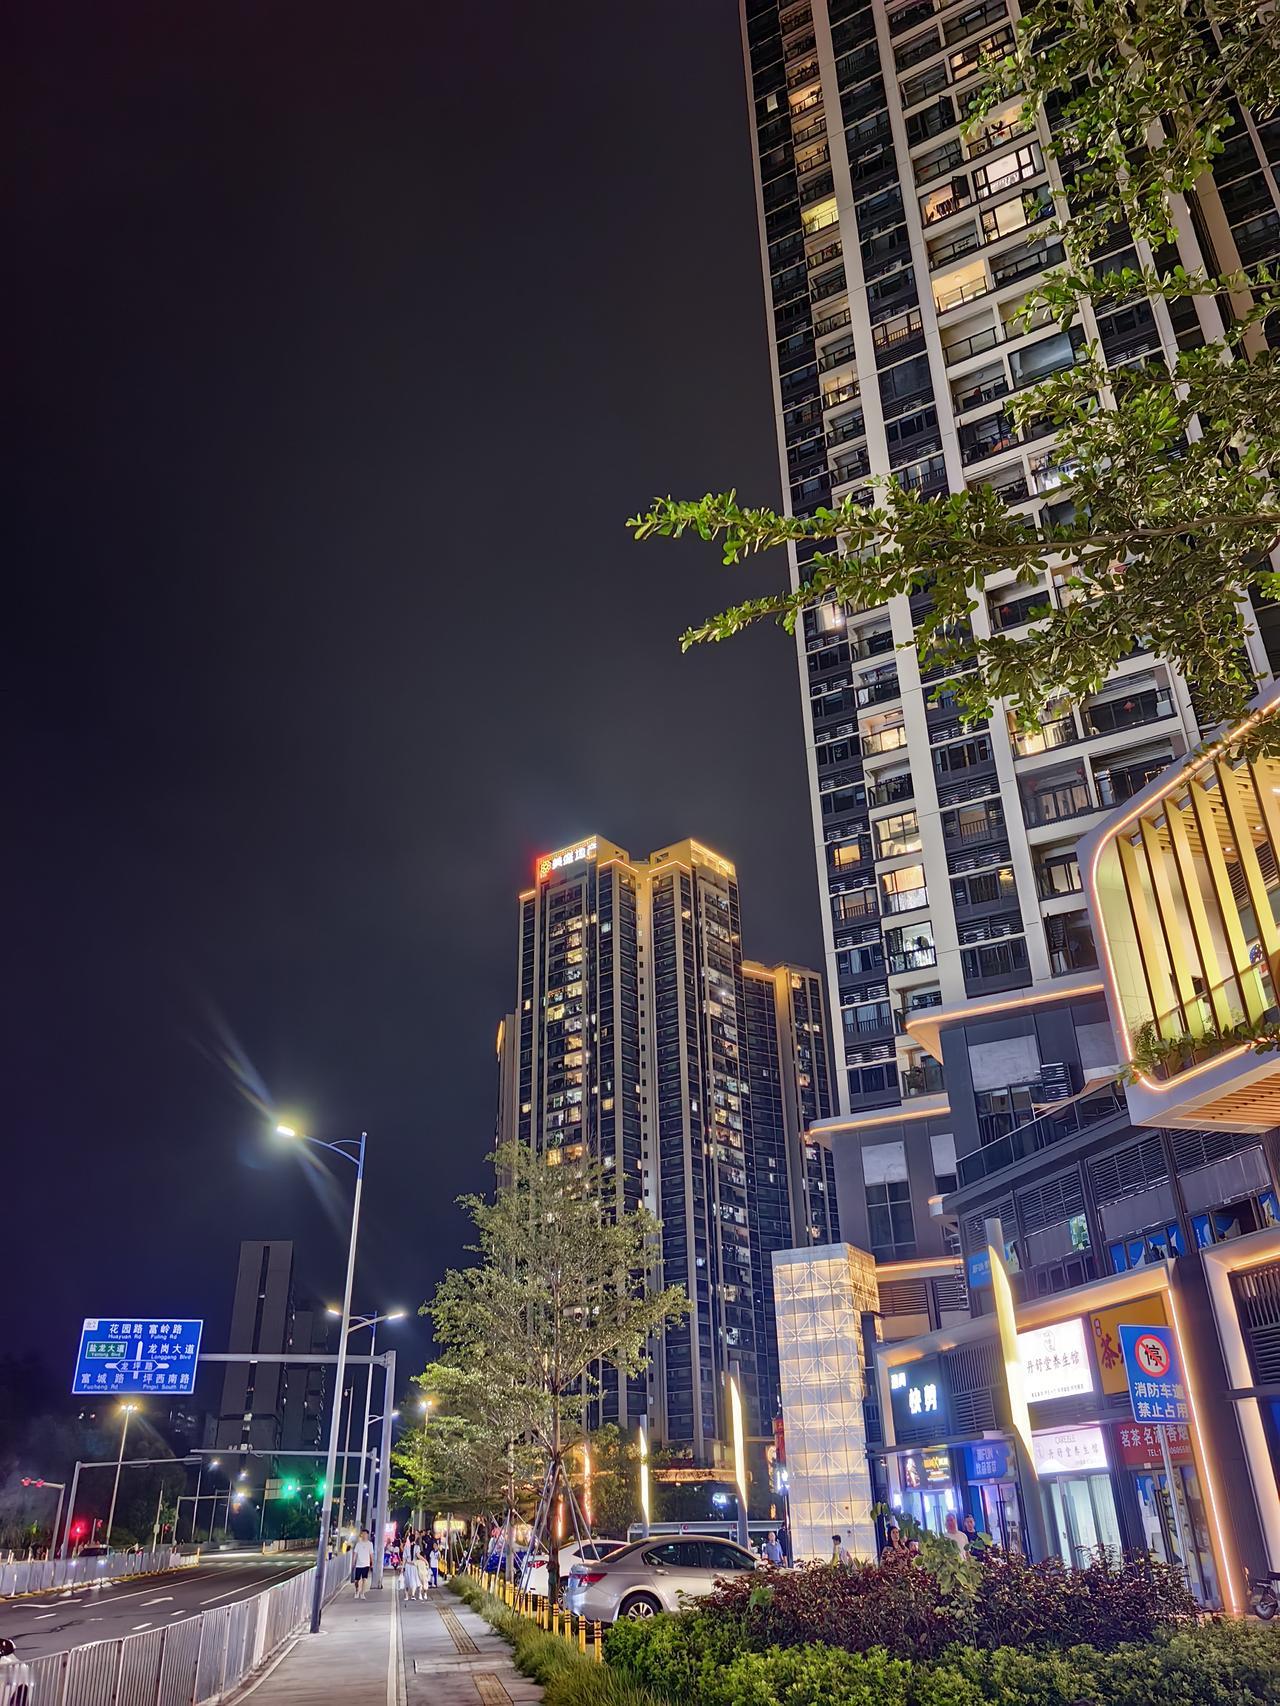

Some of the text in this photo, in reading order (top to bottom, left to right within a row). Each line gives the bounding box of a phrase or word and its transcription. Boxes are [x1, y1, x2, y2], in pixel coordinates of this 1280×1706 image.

[109, 1324, 182, 1334] 花园路 富岭路
[89, 1344, 125, 1352] 盐龙大道
[148, 1344, 195, 1354] 龙岗大道
[120, 1362, 153, 1370] 龙坪路
[81, 1373, 124, 1384] 富城路
[143, 1374, 190, 1384] 坪西南路
[1134, 1381, 1186, 1400] 消防车道
[1137, 1402, 1190, 1418] 禁止占用
